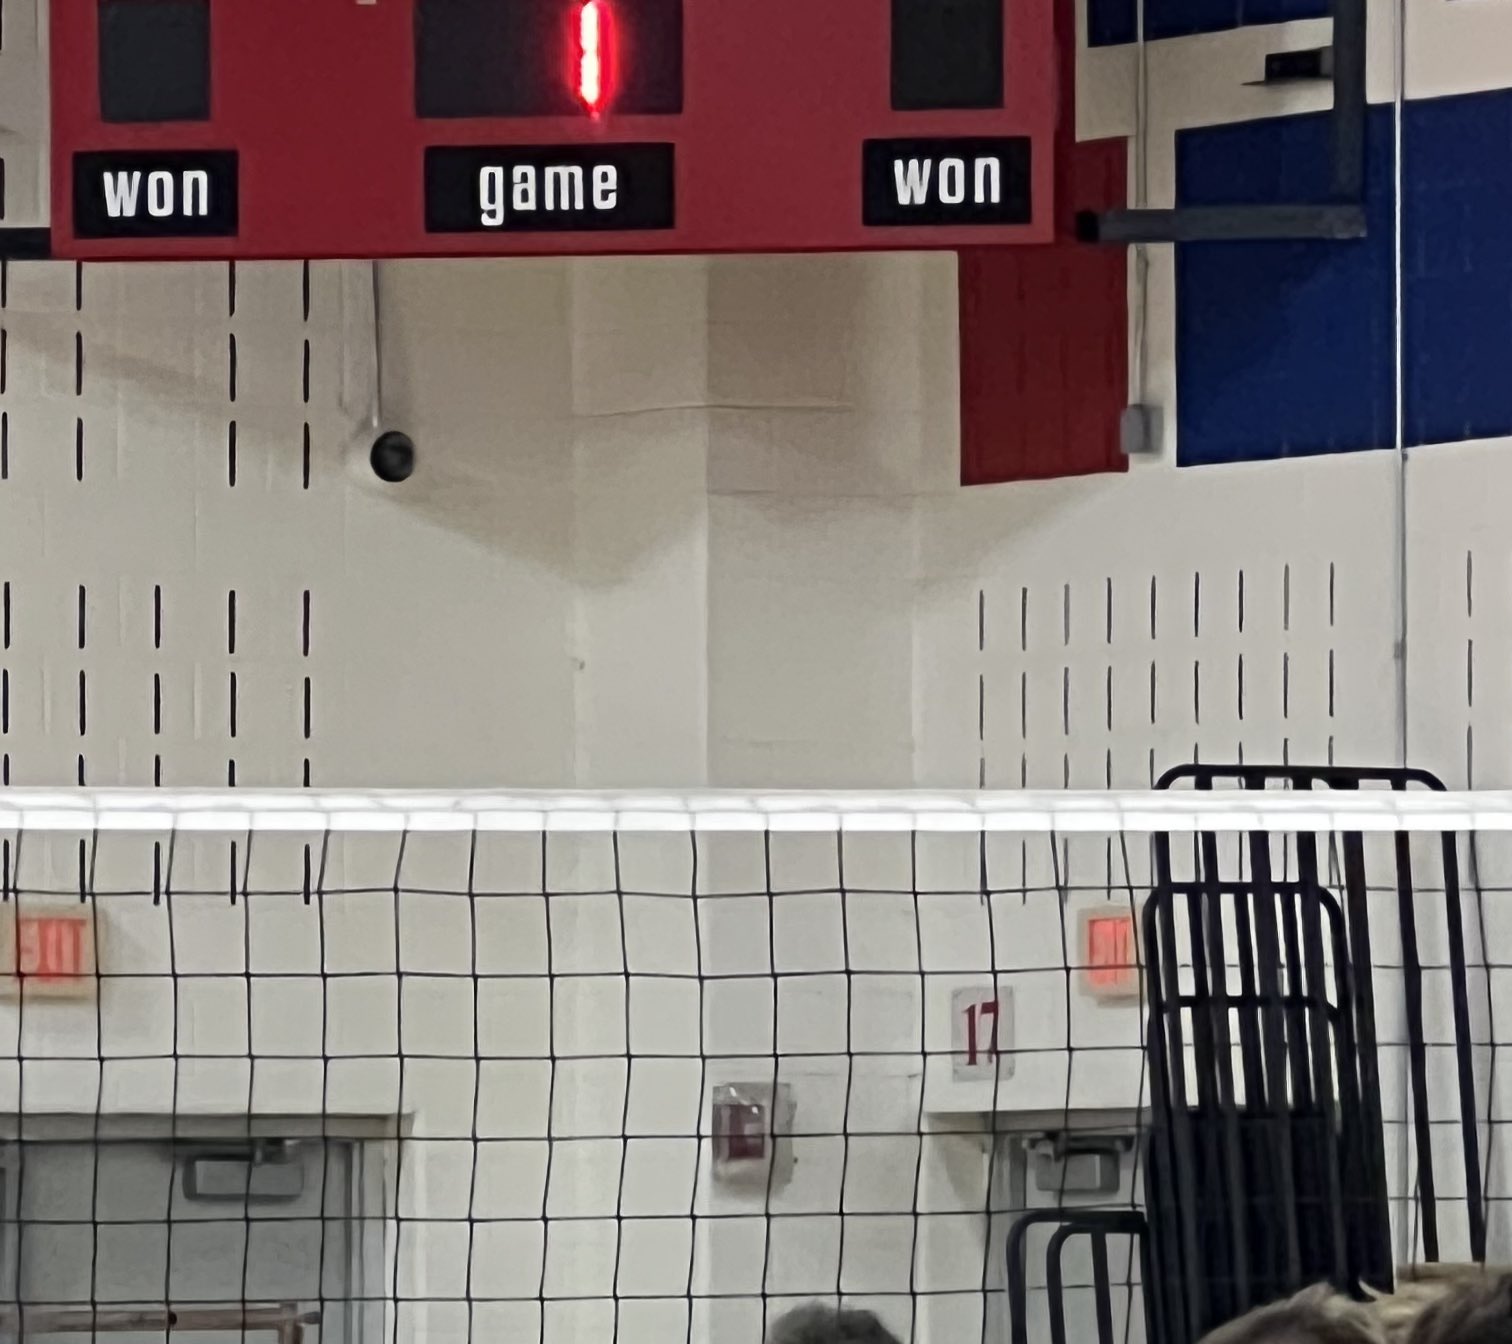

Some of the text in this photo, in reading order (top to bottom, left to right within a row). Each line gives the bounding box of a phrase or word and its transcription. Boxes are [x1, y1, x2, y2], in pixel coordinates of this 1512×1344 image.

[102, 169, 209, 217] won
[479, 164, 618, 227] game
[893, 156, 1001, 206] won
[963, 1001, 999, 1066] 17
